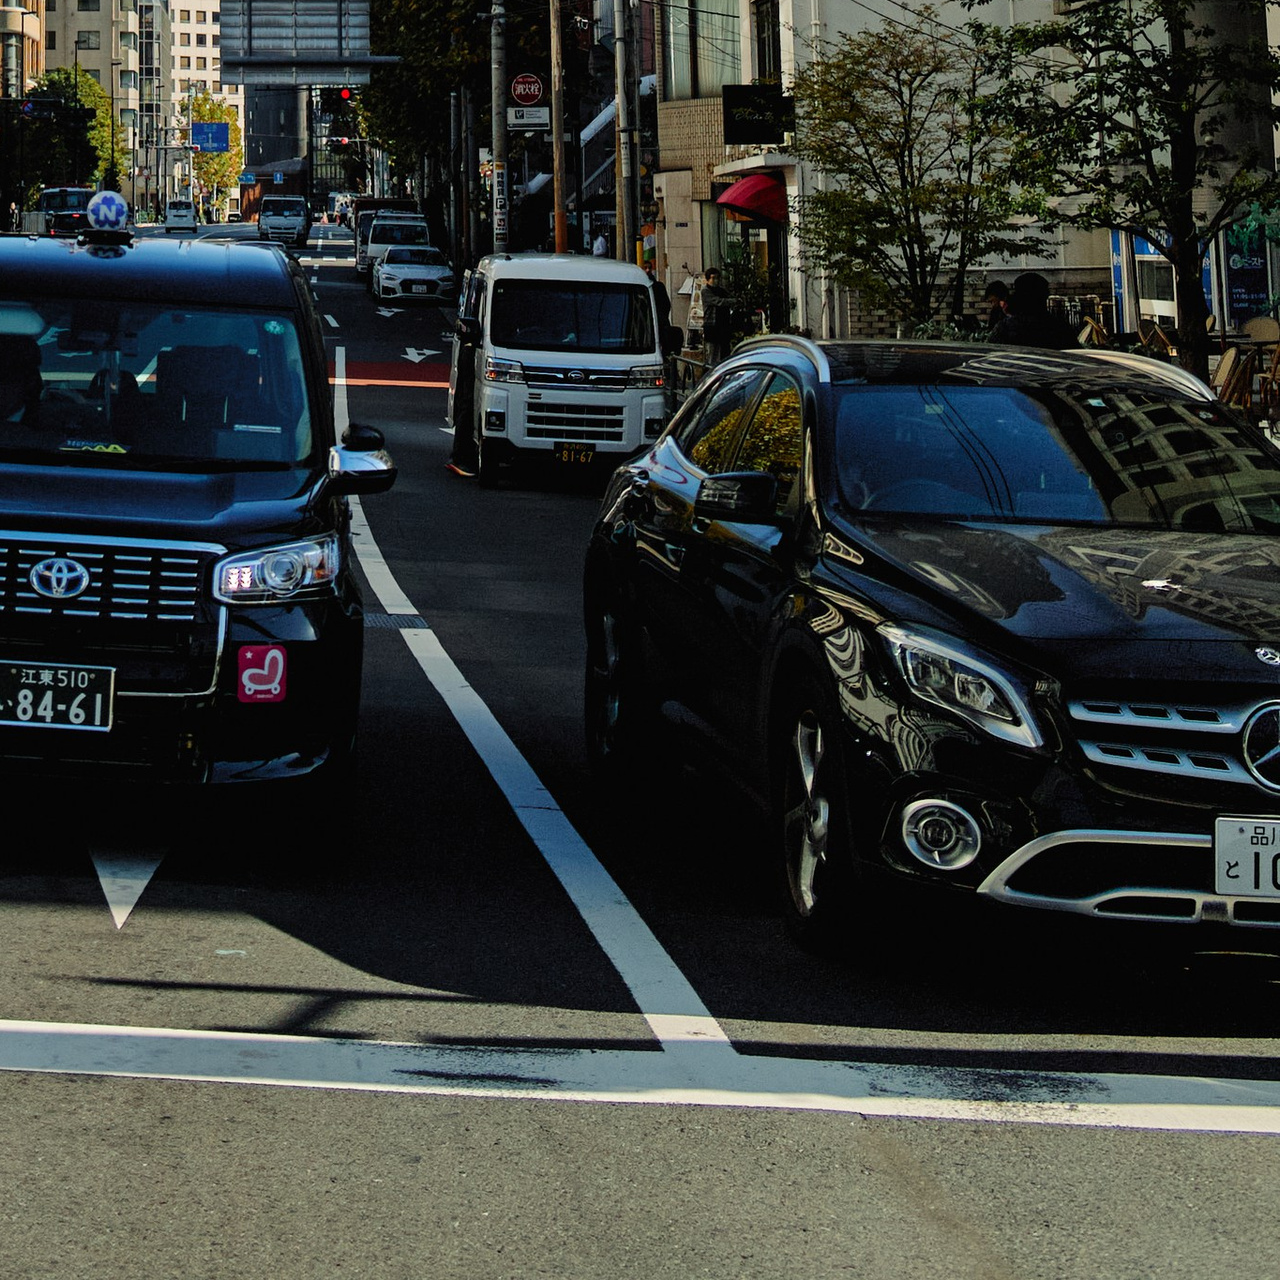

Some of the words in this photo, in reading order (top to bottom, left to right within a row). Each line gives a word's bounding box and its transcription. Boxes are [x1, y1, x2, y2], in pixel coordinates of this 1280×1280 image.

[515, 83, 540, 95] 消火栓
[99, 204, 117, 221] N
[562, 450, 594, 463] 81-67
[20, 668, 89, 688] 江東510
[16, 688, 102, 726] 84-61
[1225, 860, 1240, 879] と
